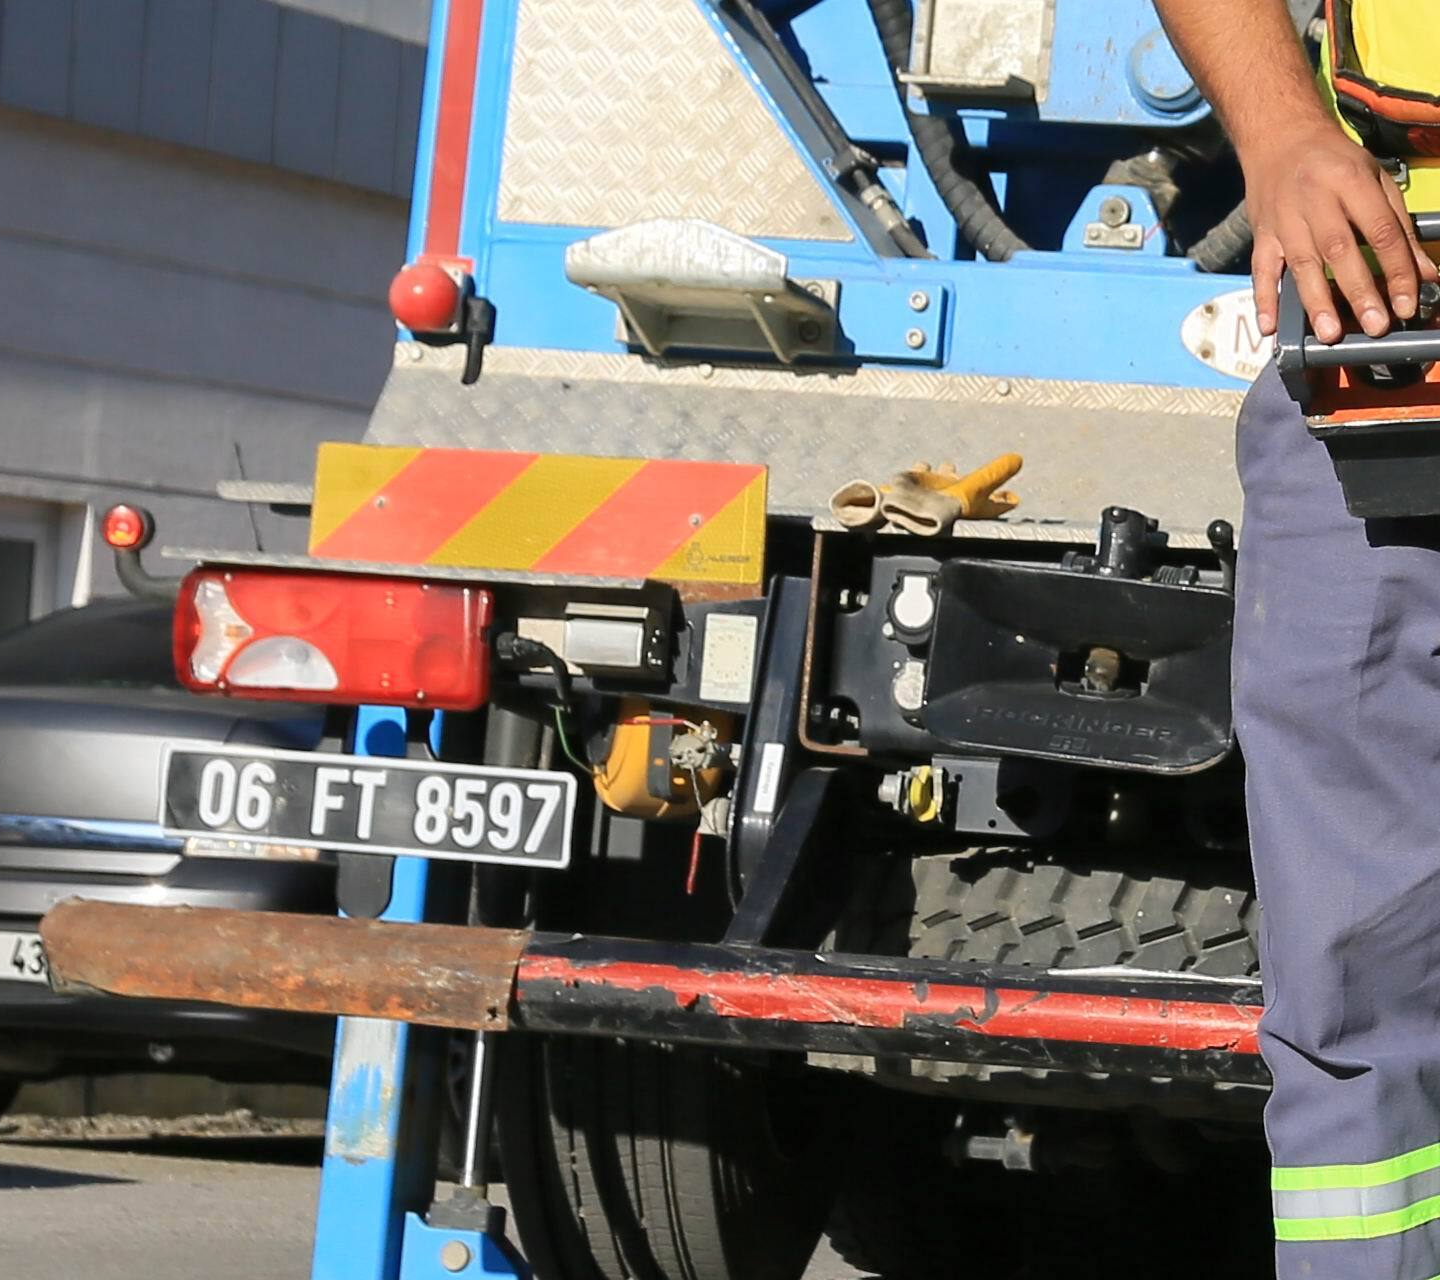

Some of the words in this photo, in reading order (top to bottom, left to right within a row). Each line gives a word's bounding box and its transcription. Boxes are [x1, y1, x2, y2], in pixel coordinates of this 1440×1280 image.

[198, 758, 276, 830] 06
[310, 767, 388, 840] FT
[413, 776, 562, 854] 8597
